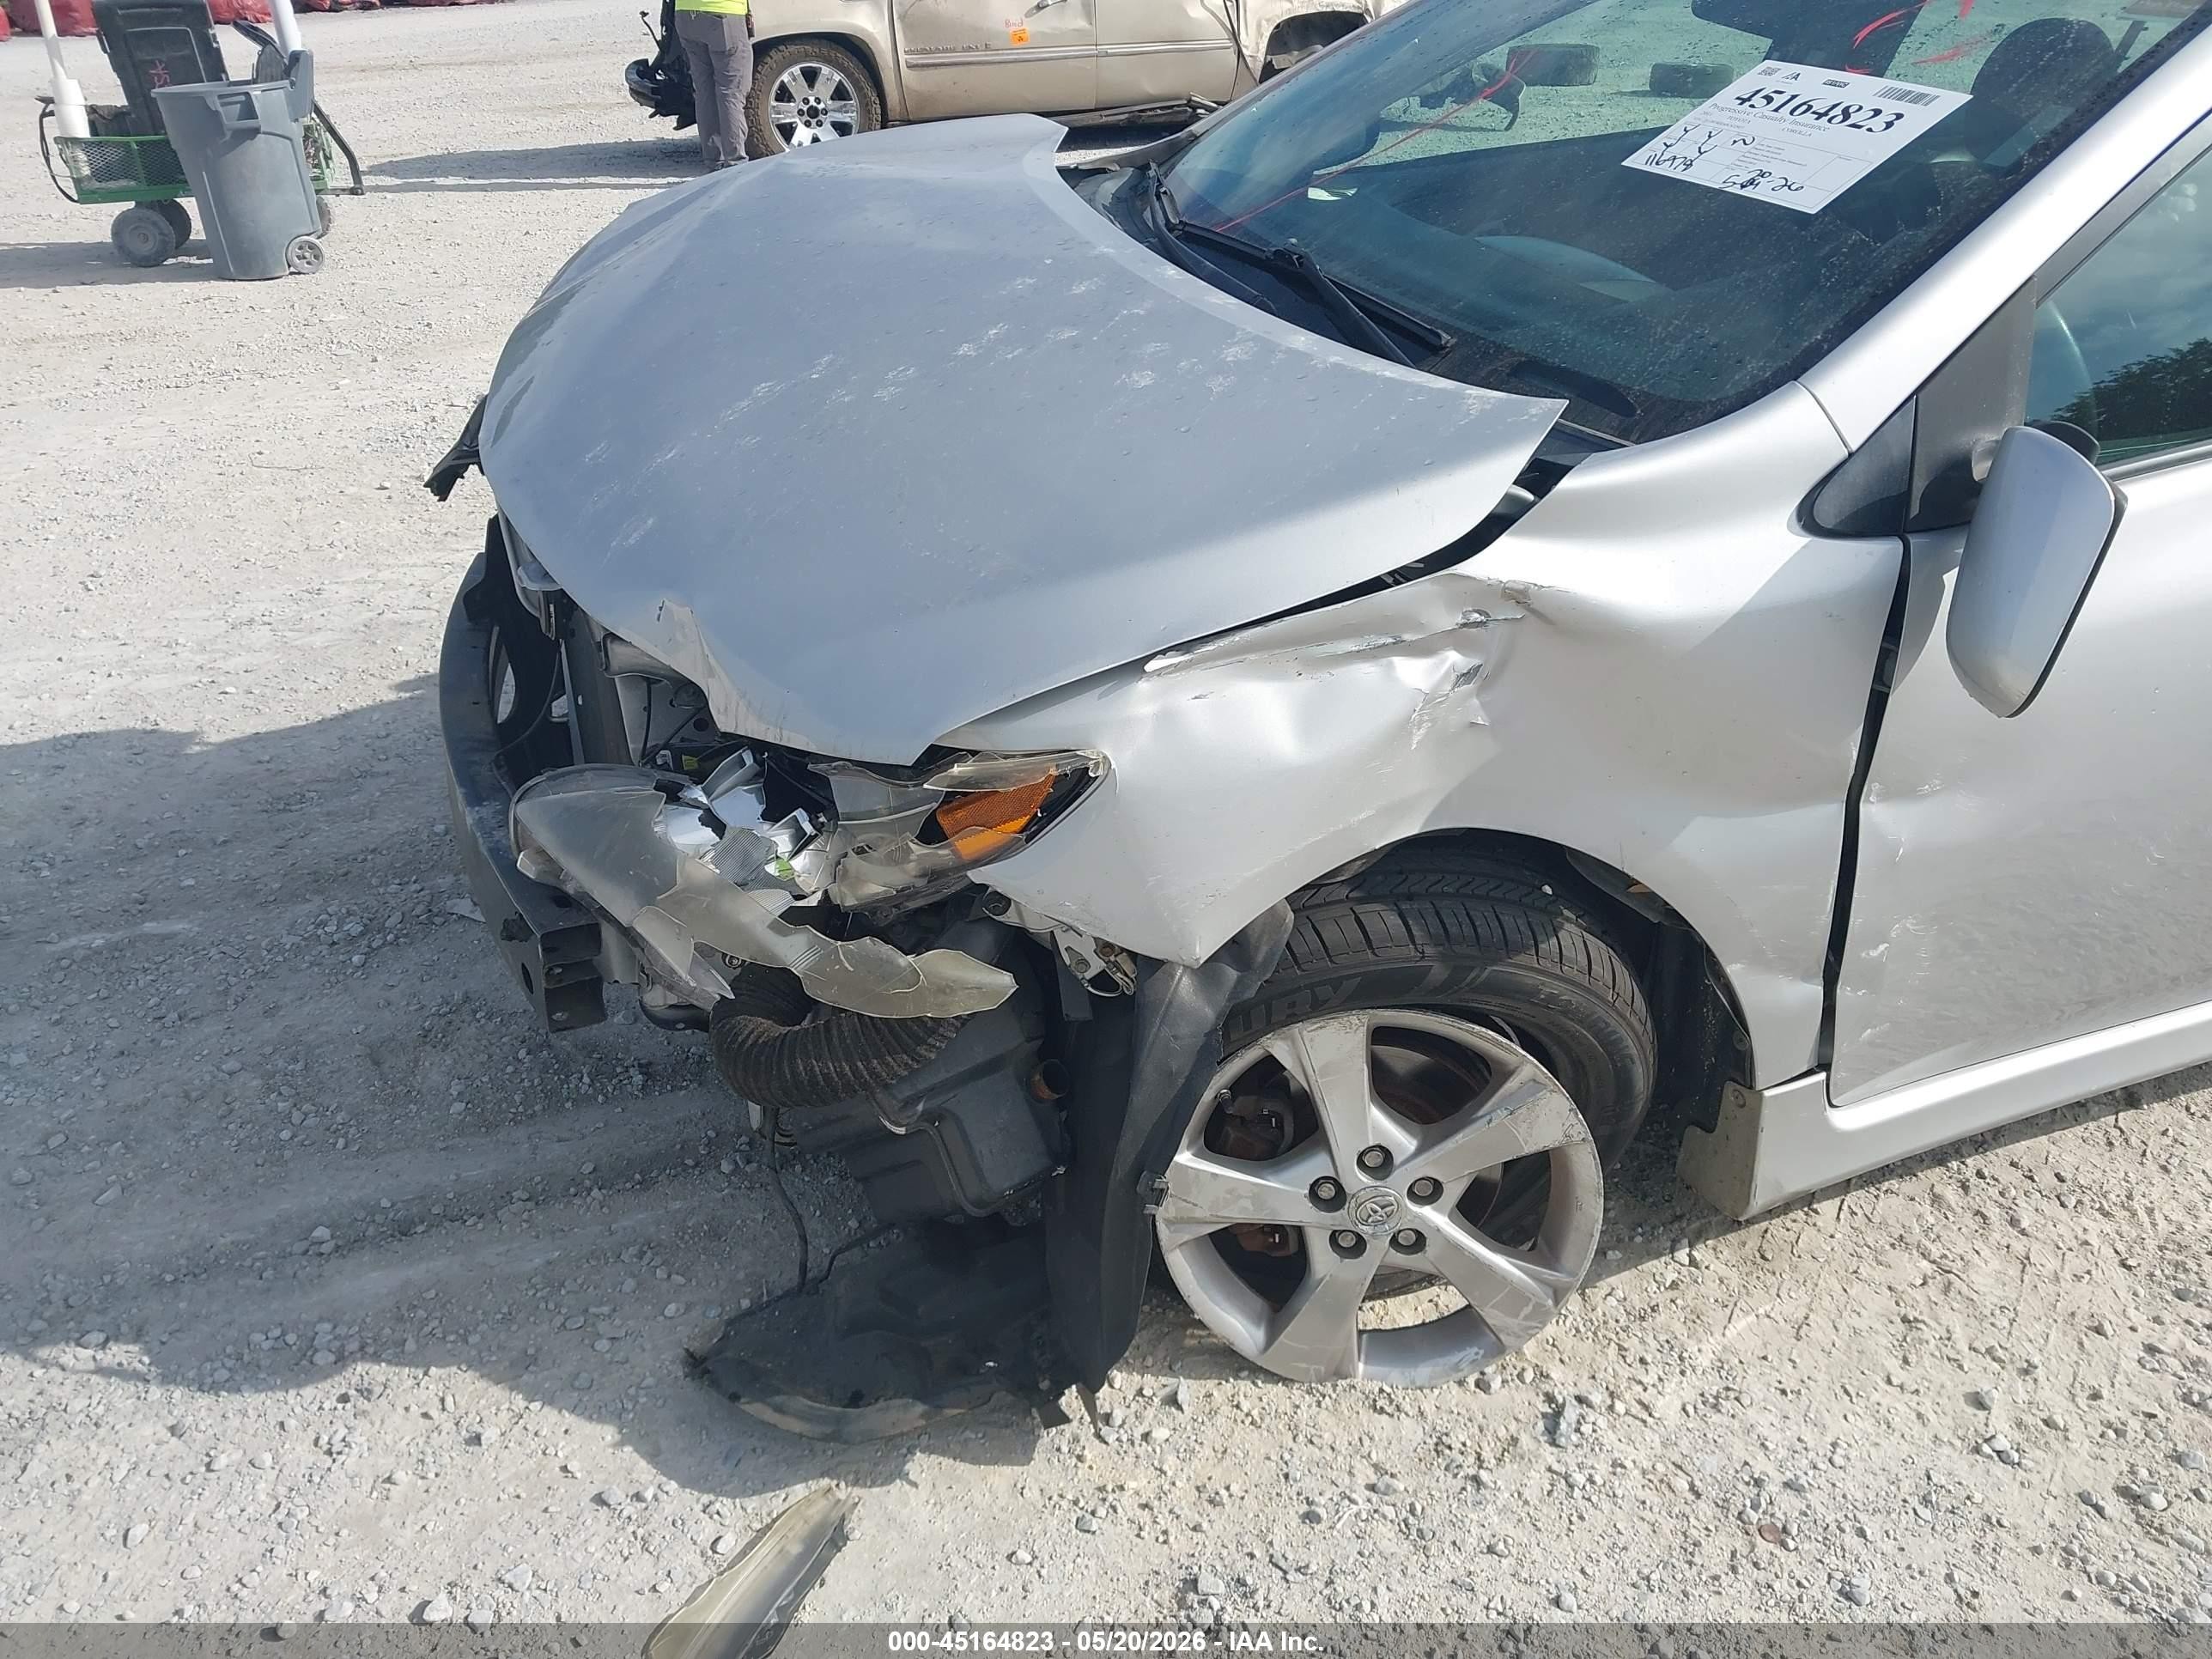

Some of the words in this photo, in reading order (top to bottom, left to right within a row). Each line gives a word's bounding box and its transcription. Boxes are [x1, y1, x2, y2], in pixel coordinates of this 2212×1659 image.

[1709, 102, 1753, 117] Progressive
[1753, 112, 1787, 124] Casualty
[1788, 118, 1830, 132] Insurance
[1733, 87, 1905, 133] 45164823
